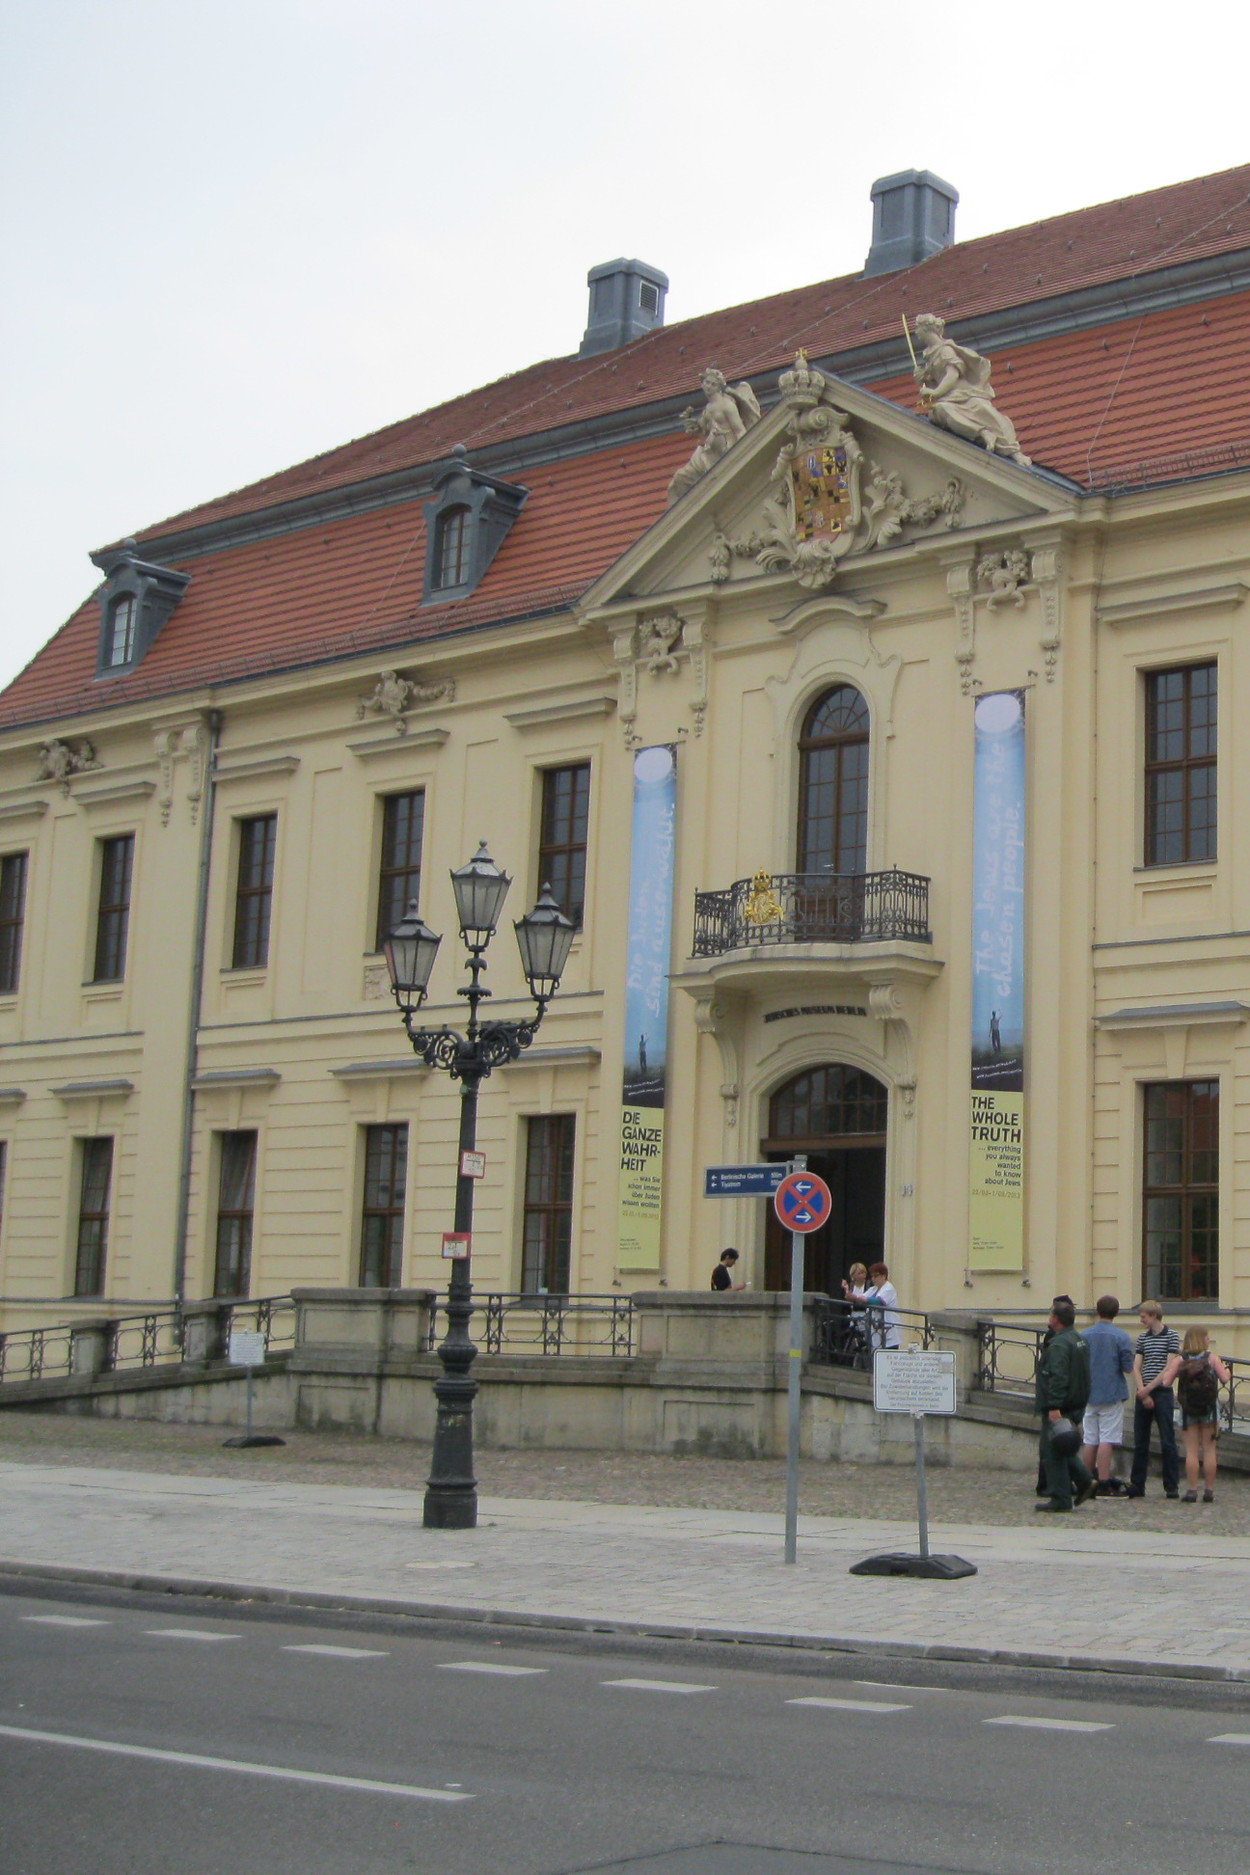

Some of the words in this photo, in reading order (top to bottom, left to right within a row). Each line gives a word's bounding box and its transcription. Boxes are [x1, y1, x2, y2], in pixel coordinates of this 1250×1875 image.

[975, 930, 997, 976] The
[836, 1005, 867, 1016] BERLIN
[971, 1096, 995, 1110] THE
[622, 1111, 641, 1125] DIE
[972, 1111, 1019, 1126] WHOLE
[622, 1126, 662, 1142] GANZE
[971, 1126, 1022, 1143] TRUTH
[622, 1141, 661, 1157] WAHR-
[987, 1144, 1021, 1155] everything
[621, 1157, 646, 1172] HEIT
[998, 1153, 1021, 1162] always
[997, 1162, 1021, 1170] wanted
[1003, 1170, 1021, 1178] know
[1005, 1179, 1021, 1187] Jews
